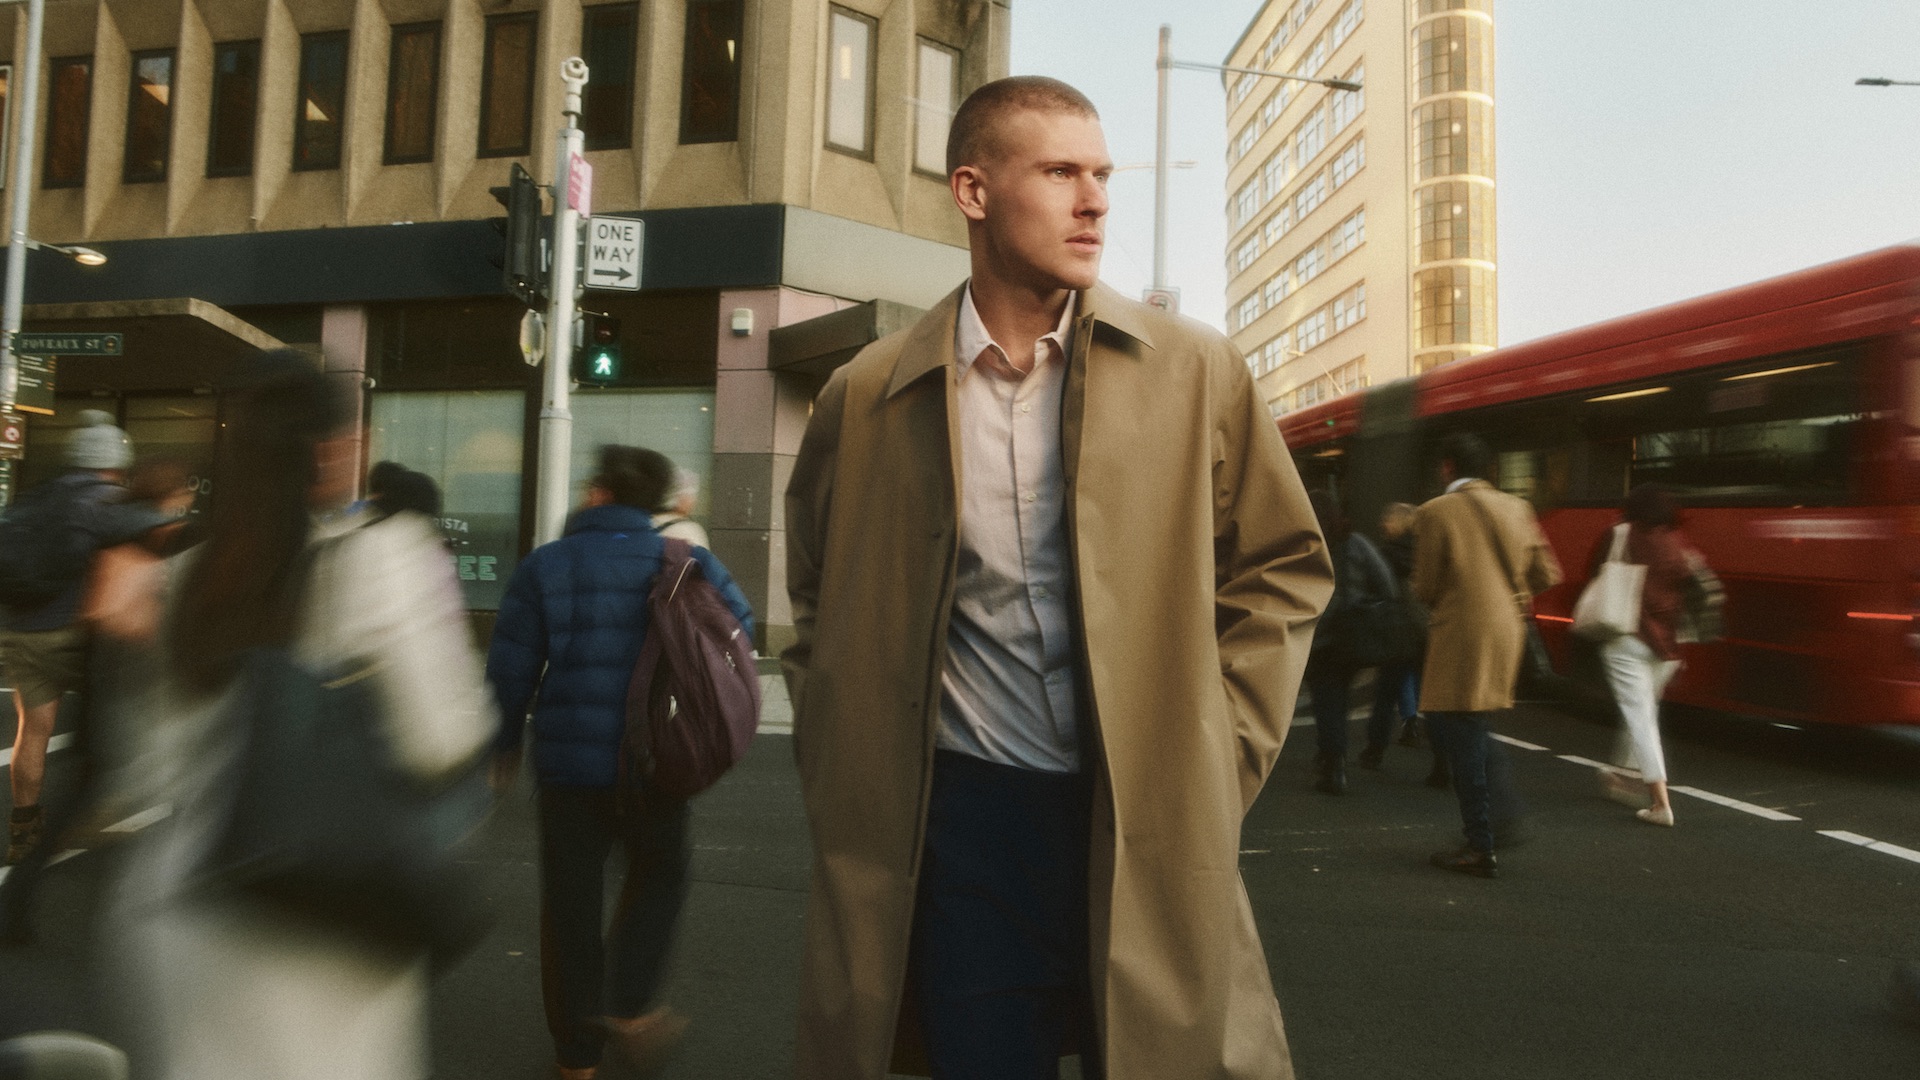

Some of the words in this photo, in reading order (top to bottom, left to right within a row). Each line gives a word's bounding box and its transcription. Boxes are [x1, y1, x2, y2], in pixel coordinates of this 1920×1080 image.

[597, 224, 633, 241] ONE
[593, 245, 635, 262] WAY
[21, 339, 79, 350] FOVEAUX
[85, 339, 99, 350] ST
